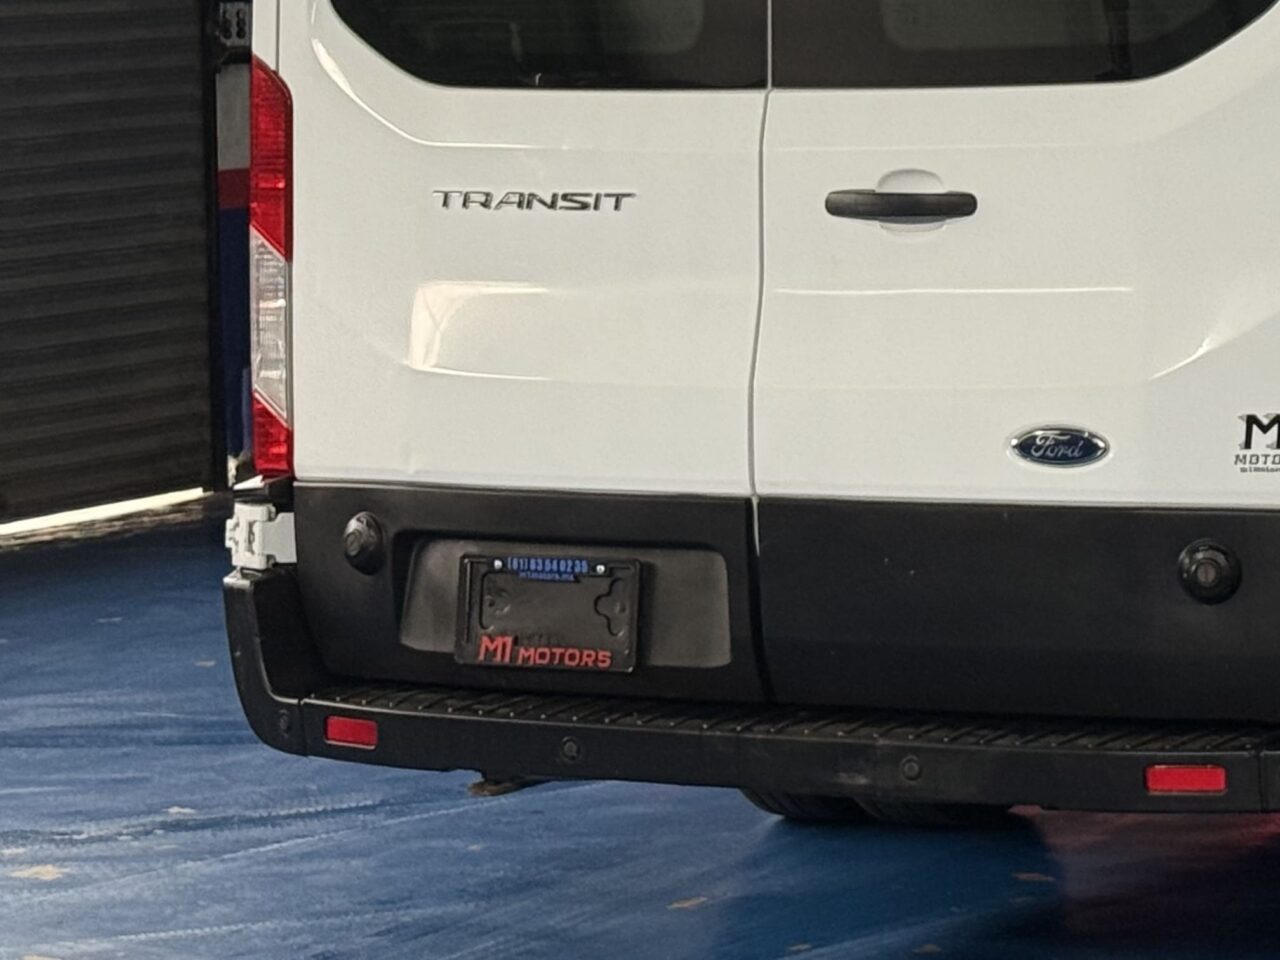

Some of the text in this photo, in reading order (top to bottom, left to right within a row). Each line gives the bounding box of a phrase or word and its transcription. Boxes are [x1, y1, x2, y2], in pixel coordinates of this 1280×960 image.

[432, 189, 637, 212] TRANSIT
[1030, 433, 1084, 458] Ford
[518, 646, 613, 668] MOTORS
